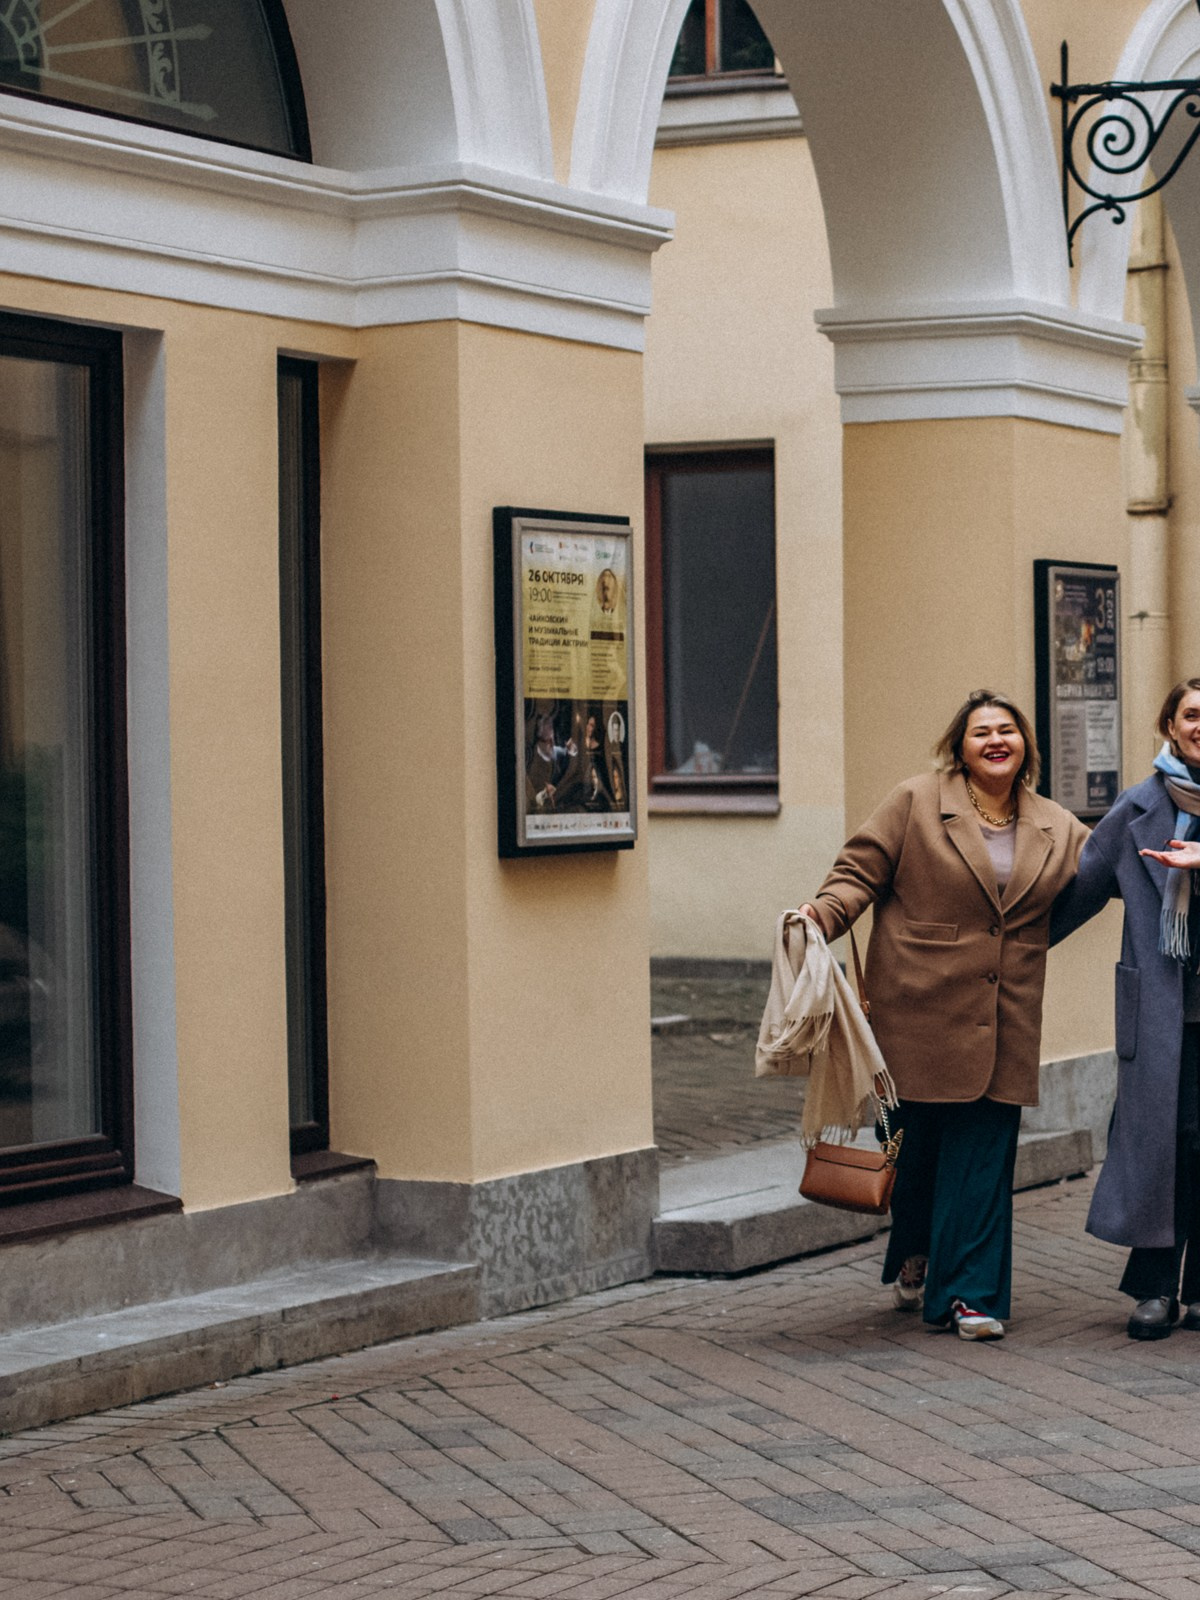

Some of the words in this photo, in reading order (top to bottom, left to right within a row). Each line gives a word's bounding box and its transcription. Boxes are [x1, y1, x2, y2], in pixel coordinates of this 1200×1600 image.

[528, 569, 541, 582] 26
[542, 570, 584, 585] ОКТЯБРЯ
[529, 586, 552, 603] 19:00
